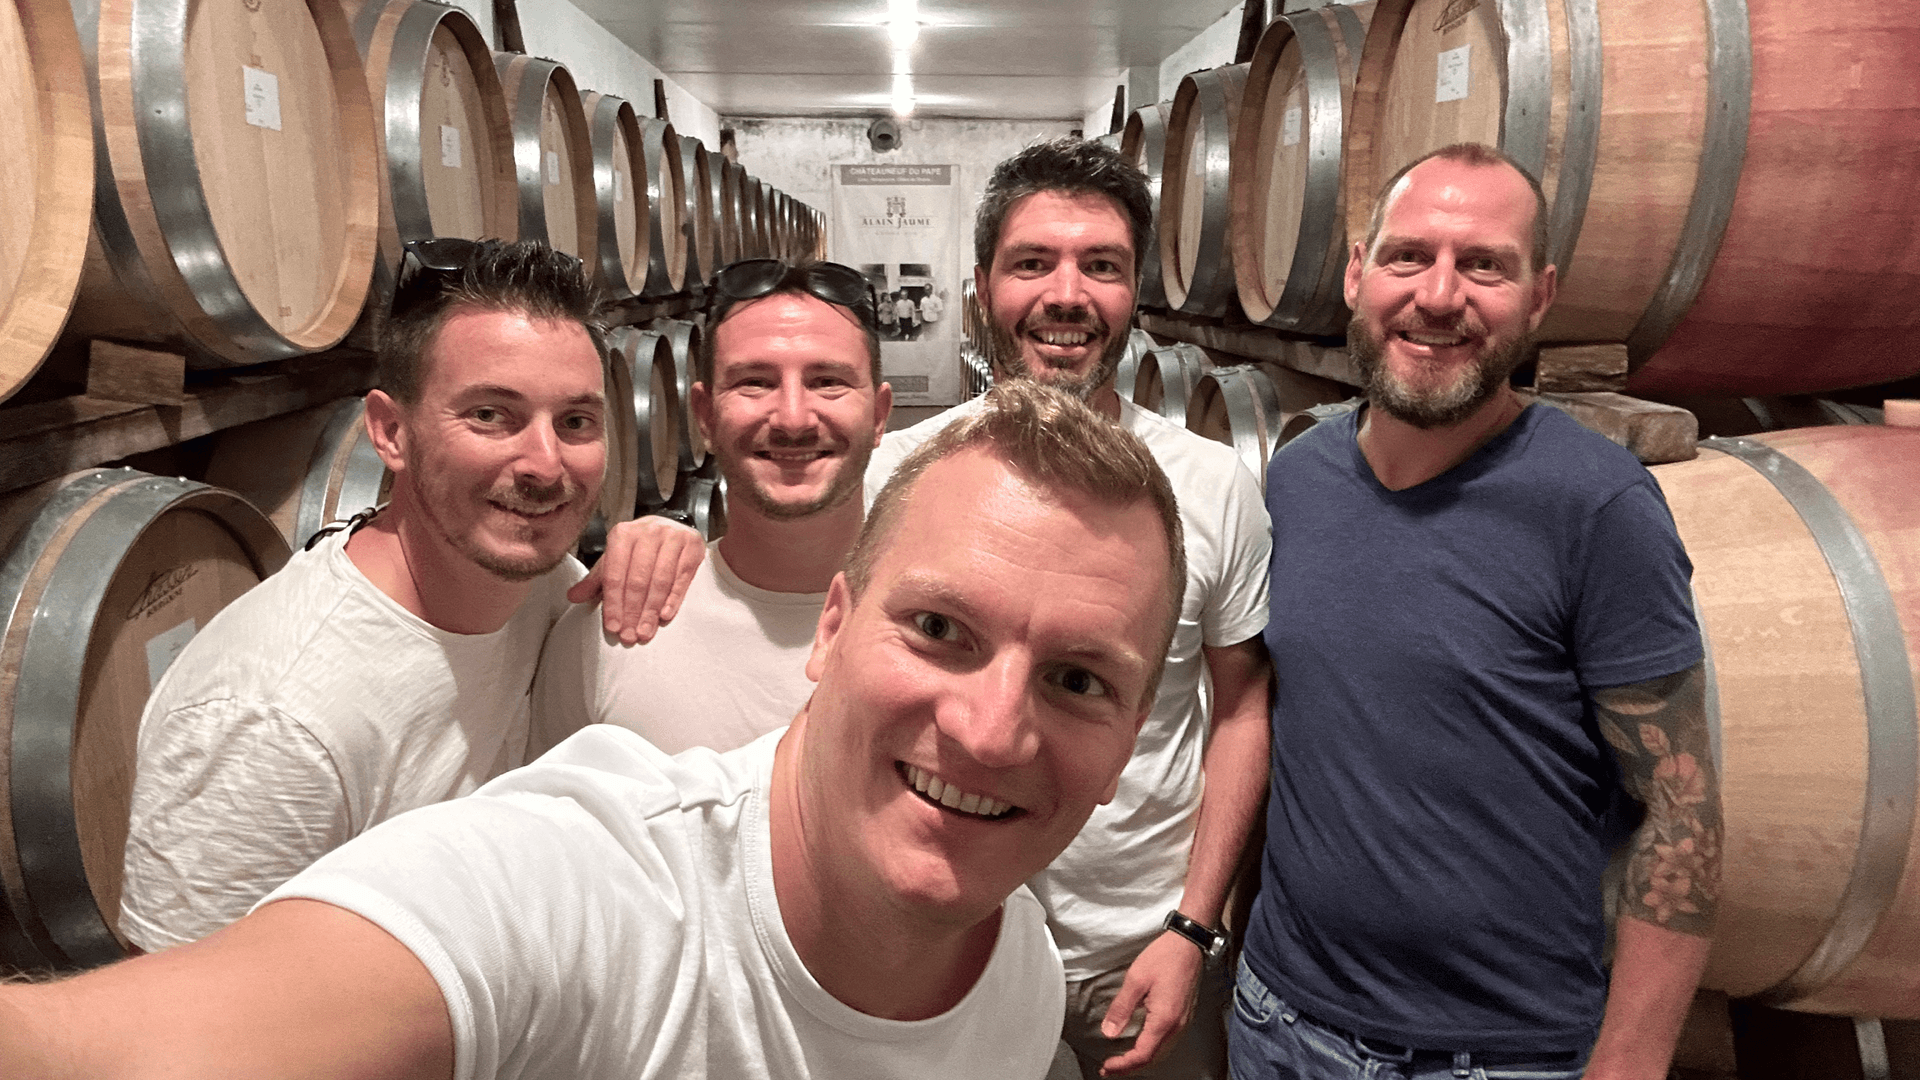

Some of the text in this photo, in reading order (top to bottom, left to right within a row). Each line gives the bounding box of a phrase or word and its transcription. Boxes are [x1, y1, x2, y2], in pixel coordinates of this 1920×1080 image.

[909, 167, 920, 176] DU
[921, 167, 942, 176] PAPE
[862, 217, 931, 229] ALAIN JAUME
